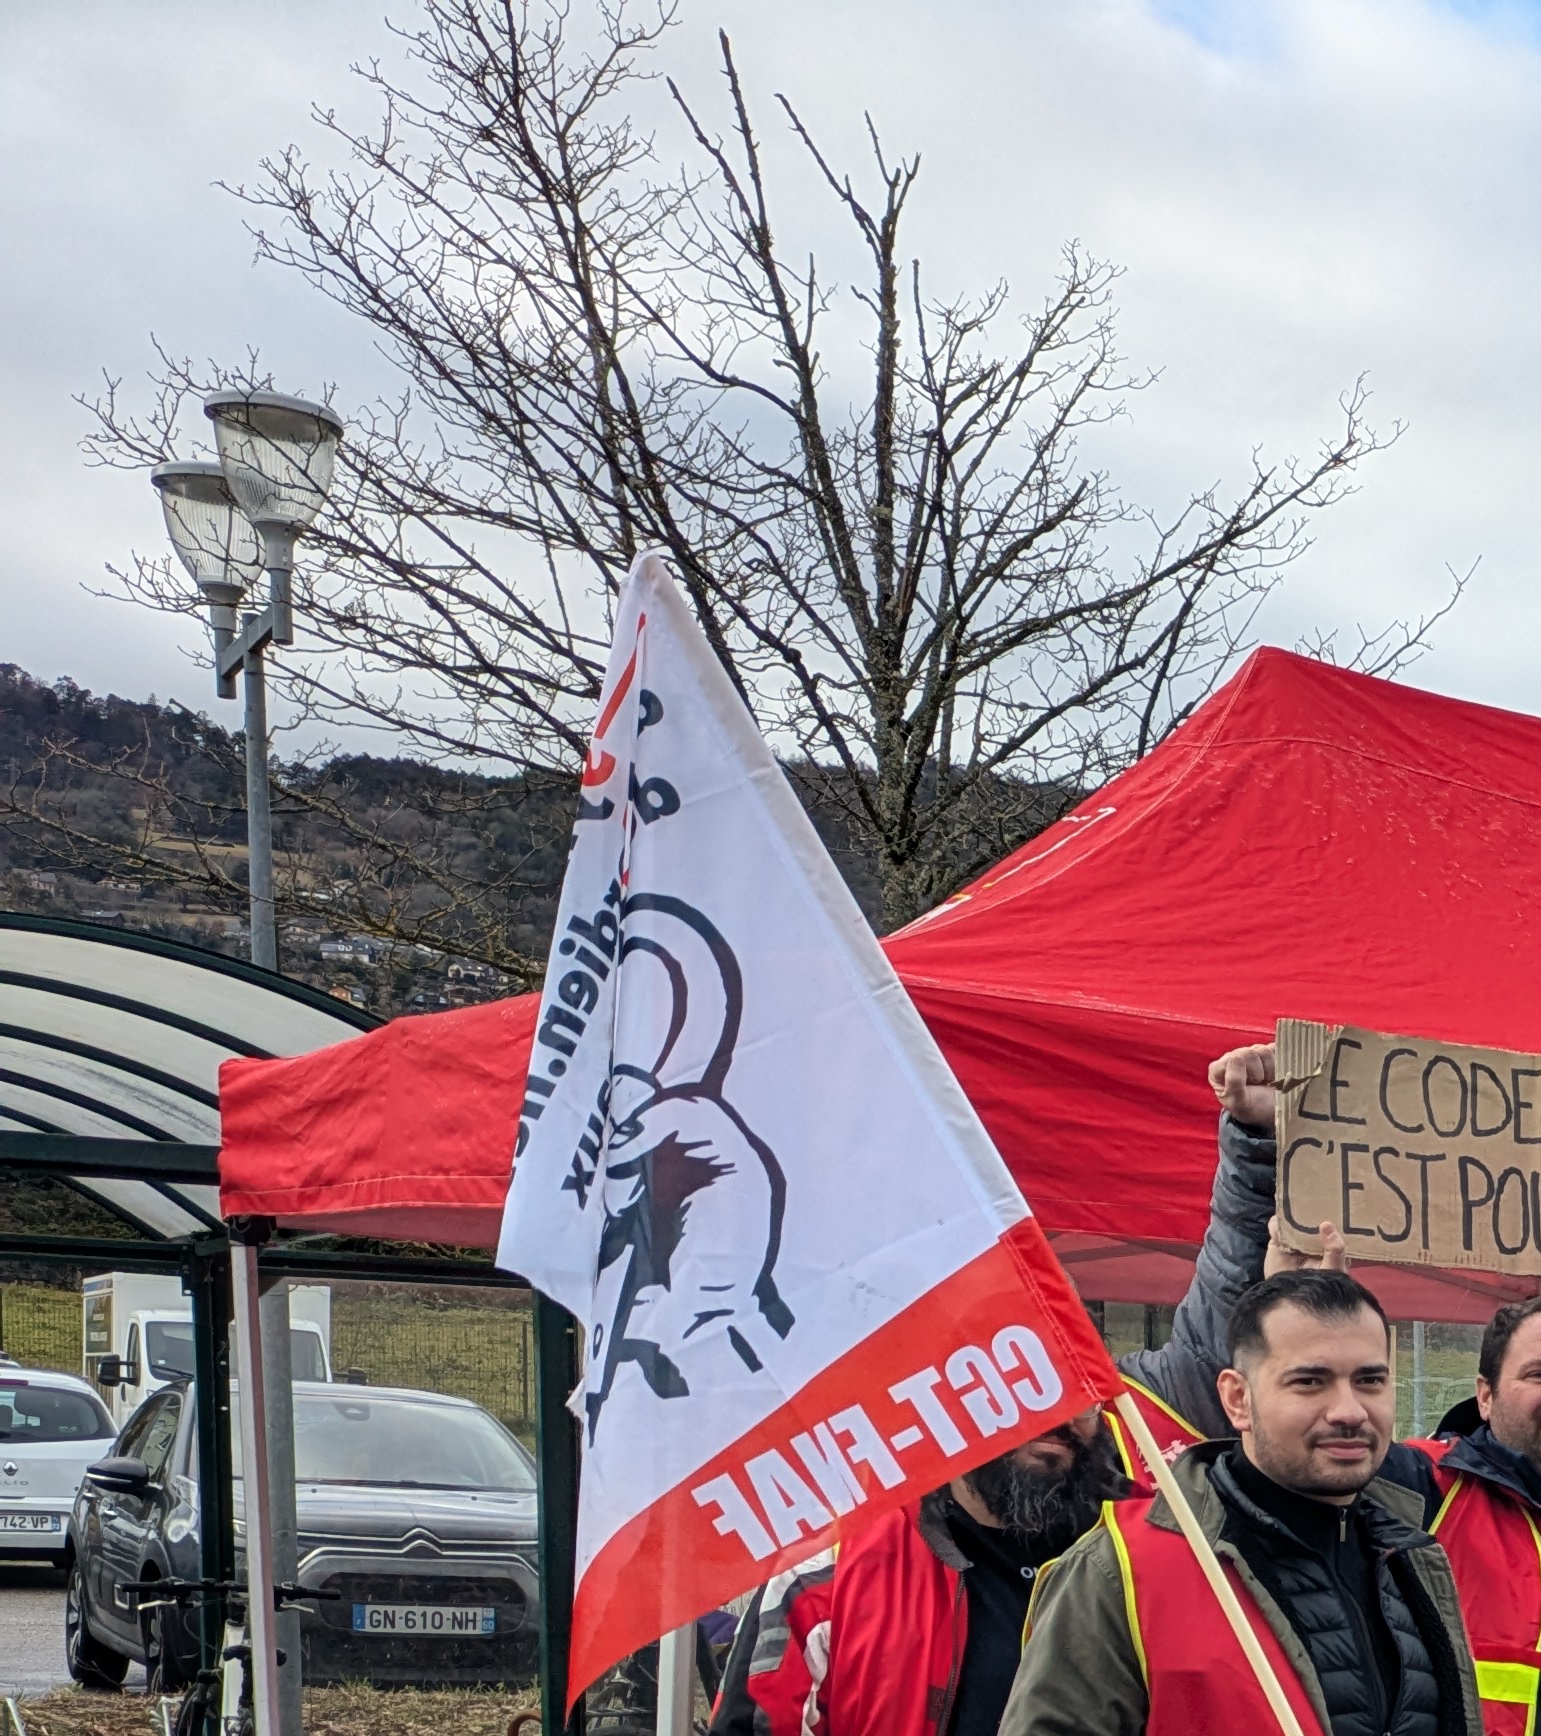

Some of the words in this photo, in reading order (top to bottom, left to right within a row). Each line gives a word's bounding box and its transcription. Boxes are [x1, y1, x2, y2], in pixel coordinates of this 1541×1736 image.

[1299, 1038, 1367, 1127] LE
[1283, 1138, 1446, 1251] C'EST
[369, 1610, 477, 1630] GN-610-NH
